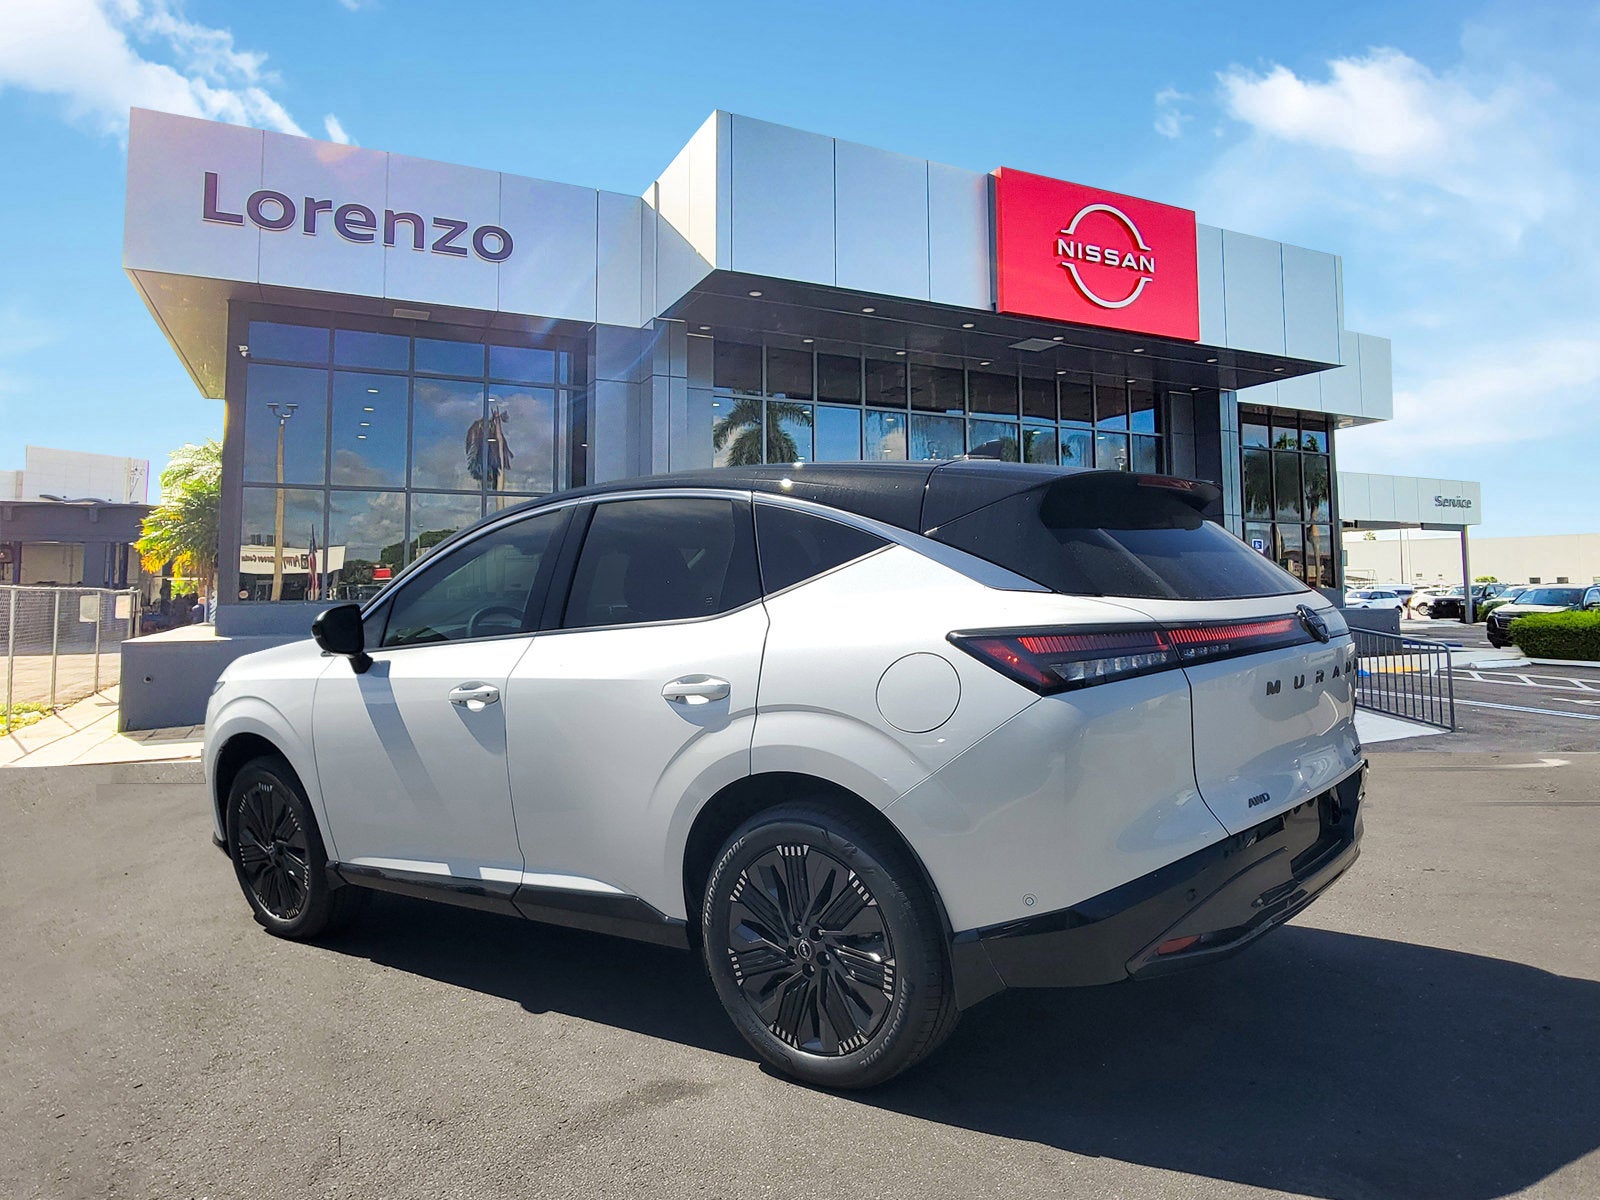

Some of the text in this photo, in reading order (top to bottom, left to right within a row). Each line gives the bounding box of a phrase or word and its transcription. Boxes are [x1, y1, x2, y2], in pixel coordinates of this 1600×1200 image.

[203, 171, 515, 263] Lorenzo
[1057, 238, 1155, 273] NISSAN
[1434, 495, 1472, 509] Service
[1248, 792, 1271, 808] AWD
